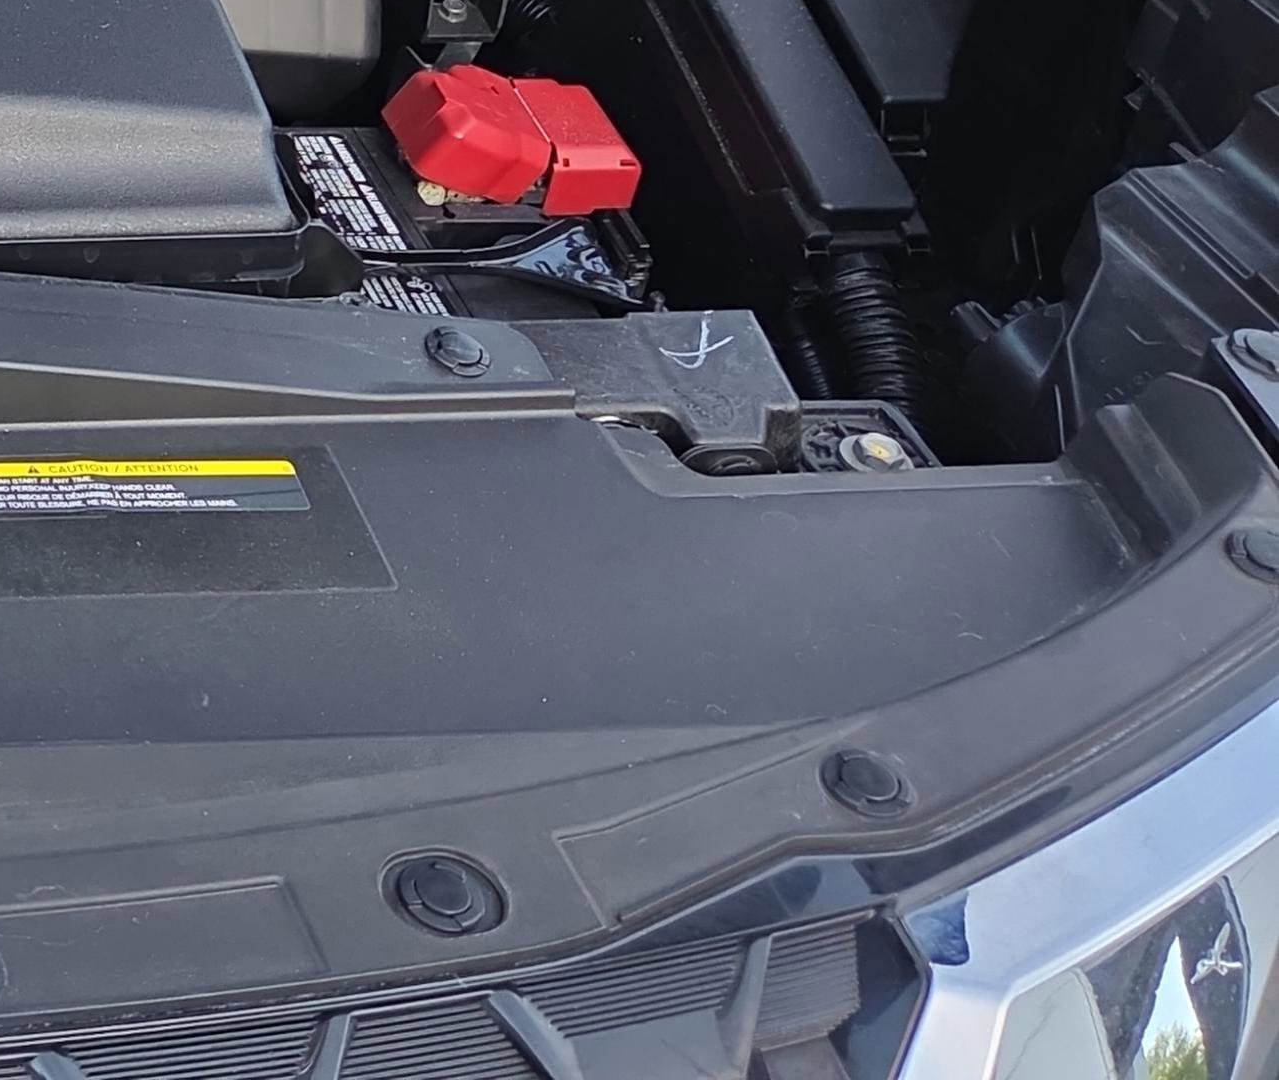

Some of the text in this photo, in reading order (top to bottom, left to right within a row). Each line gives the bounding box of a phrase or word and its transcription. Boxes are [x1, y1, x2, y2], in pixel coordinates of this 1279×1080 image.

[48, 464, 109, 474] CAUTION
[125, 464, 200, 473] ATTENTION
[12, 477, 38, 485] START
[17, 493, 51, 501] RISQUE
[122, 492, 145, 500] TOUT
[8, 501, 36, 509] TOUTE
[189, 499, 206, 507] LES
